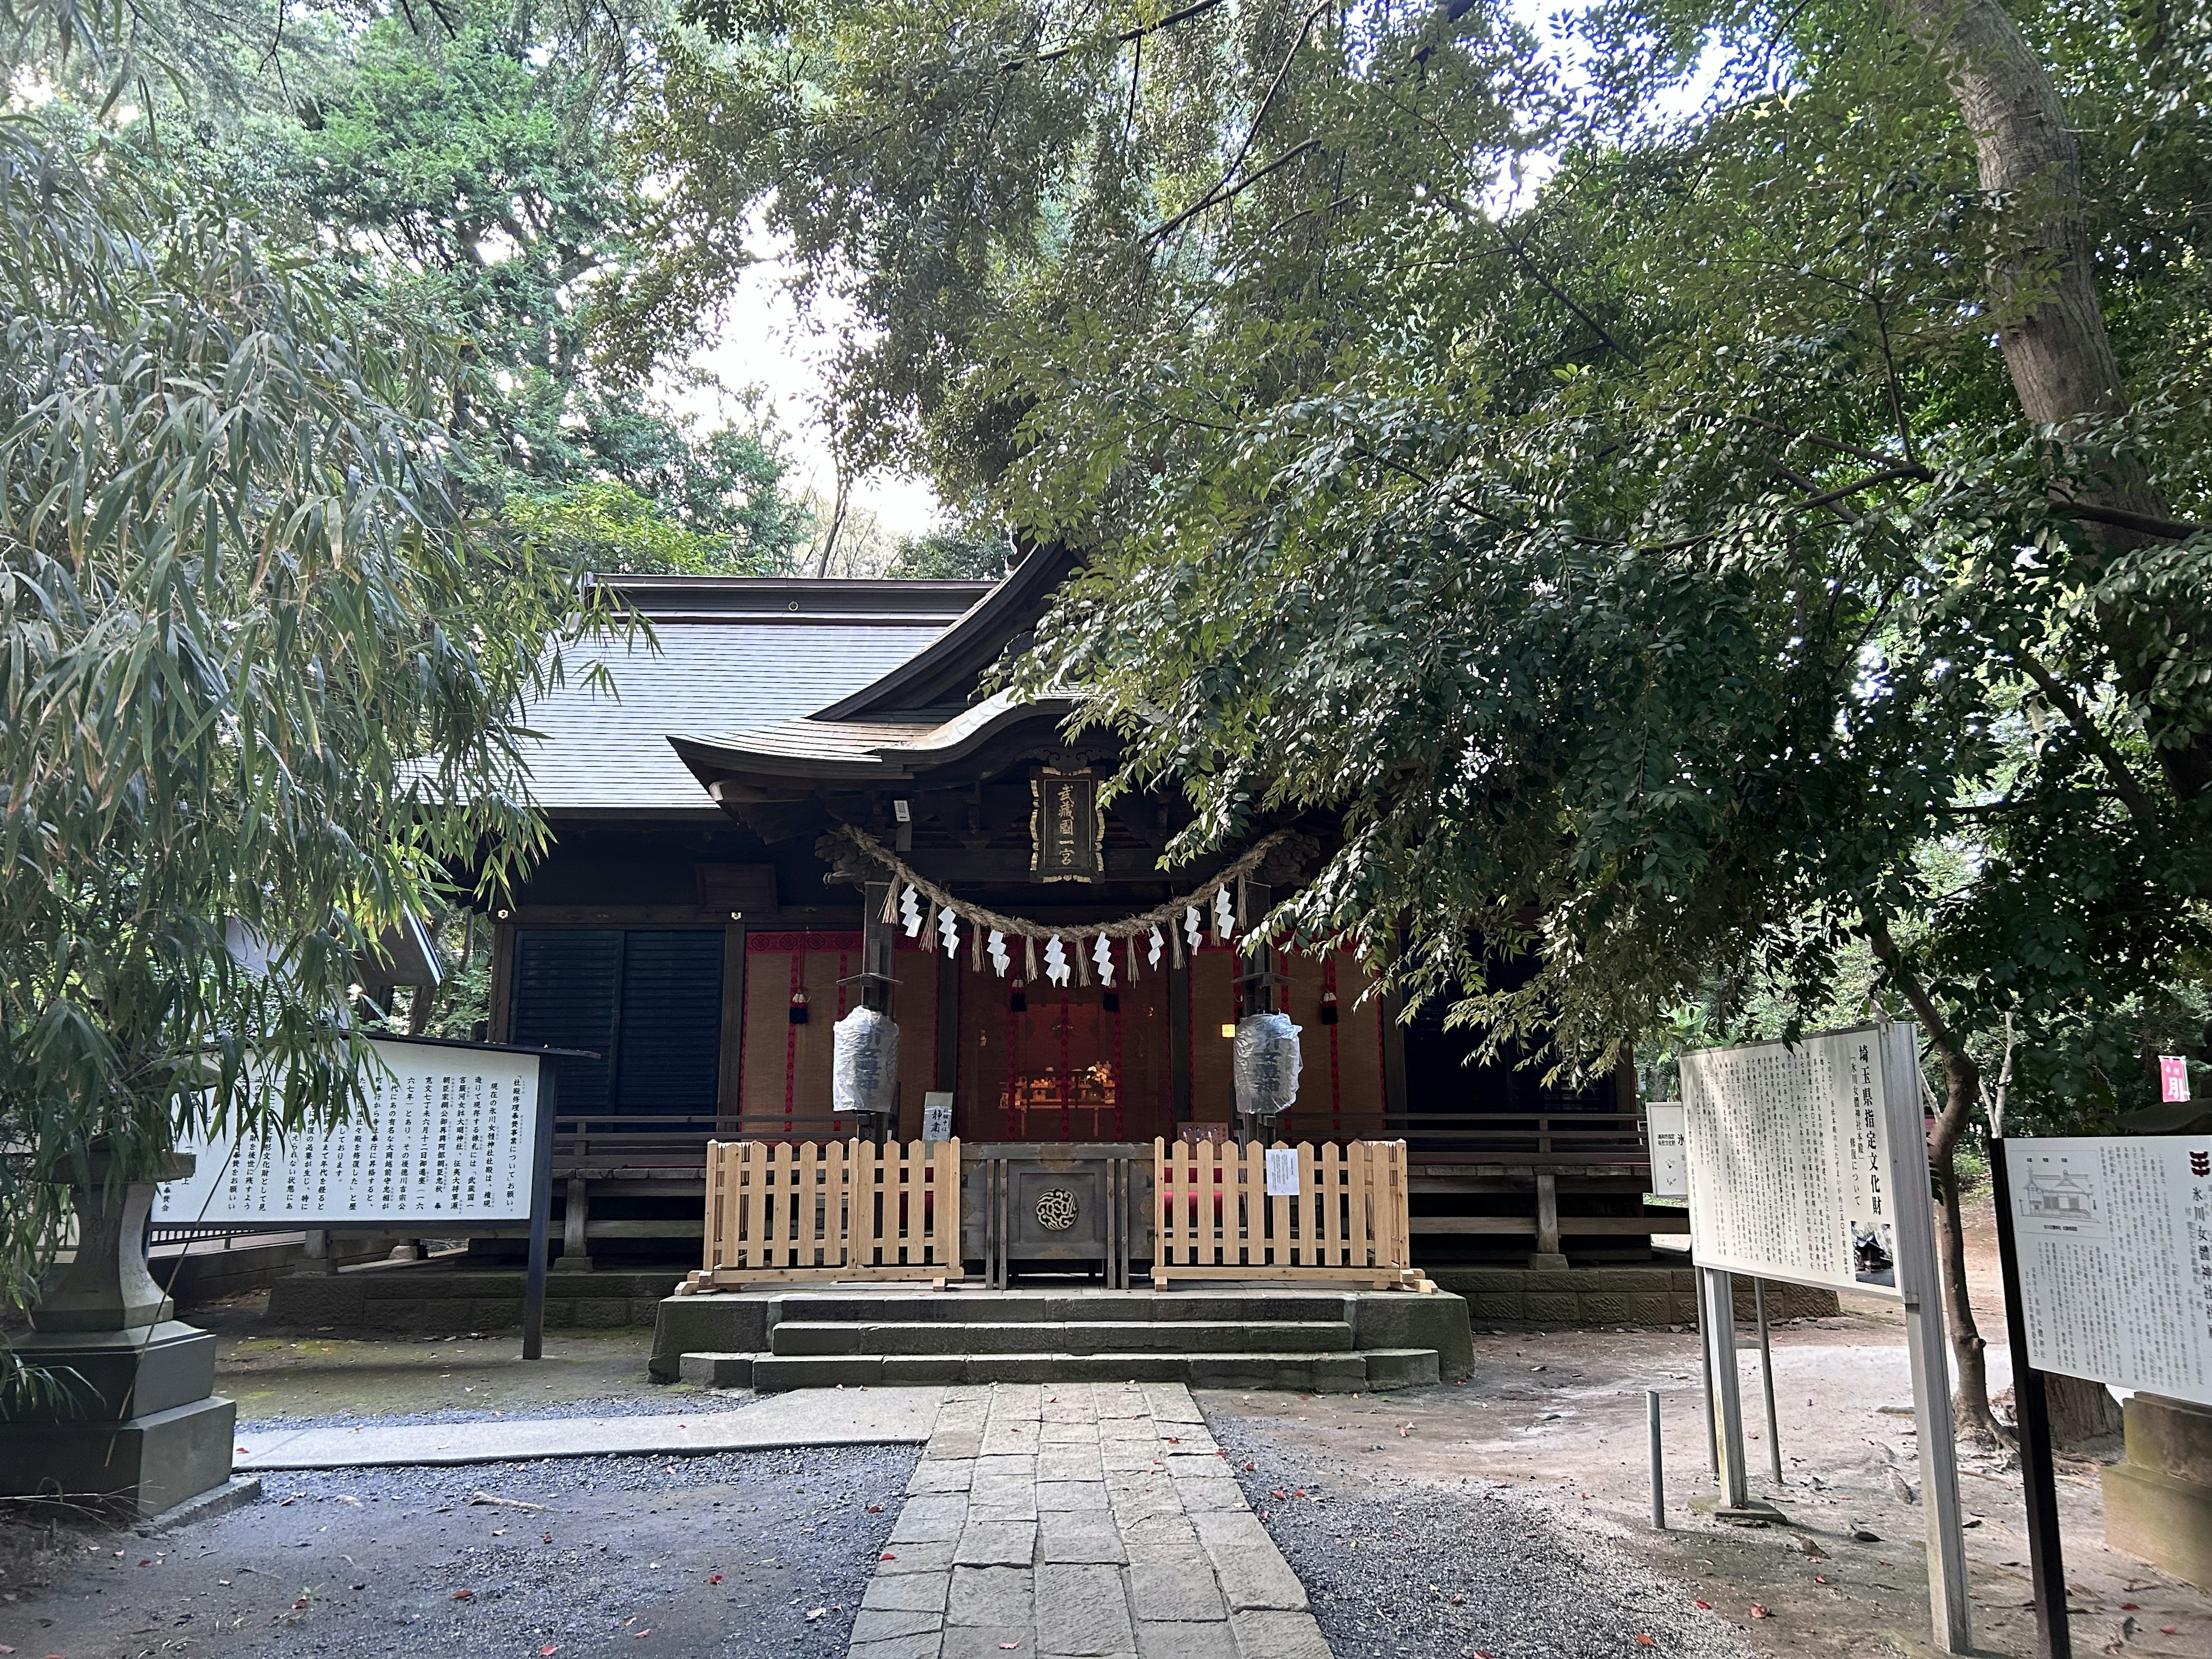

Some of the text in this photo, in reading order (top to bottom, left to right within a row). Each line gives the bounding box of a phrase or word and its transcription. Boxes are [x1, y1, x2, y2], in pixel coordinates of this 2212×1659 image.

[349, 1077, 366, 1210] ただに当社々殿を修復した」と歴
[1850, 1138, 1861, 1206] 修復について
[1858, 1045, 1883, 1215] 埼玉県指定文化財
